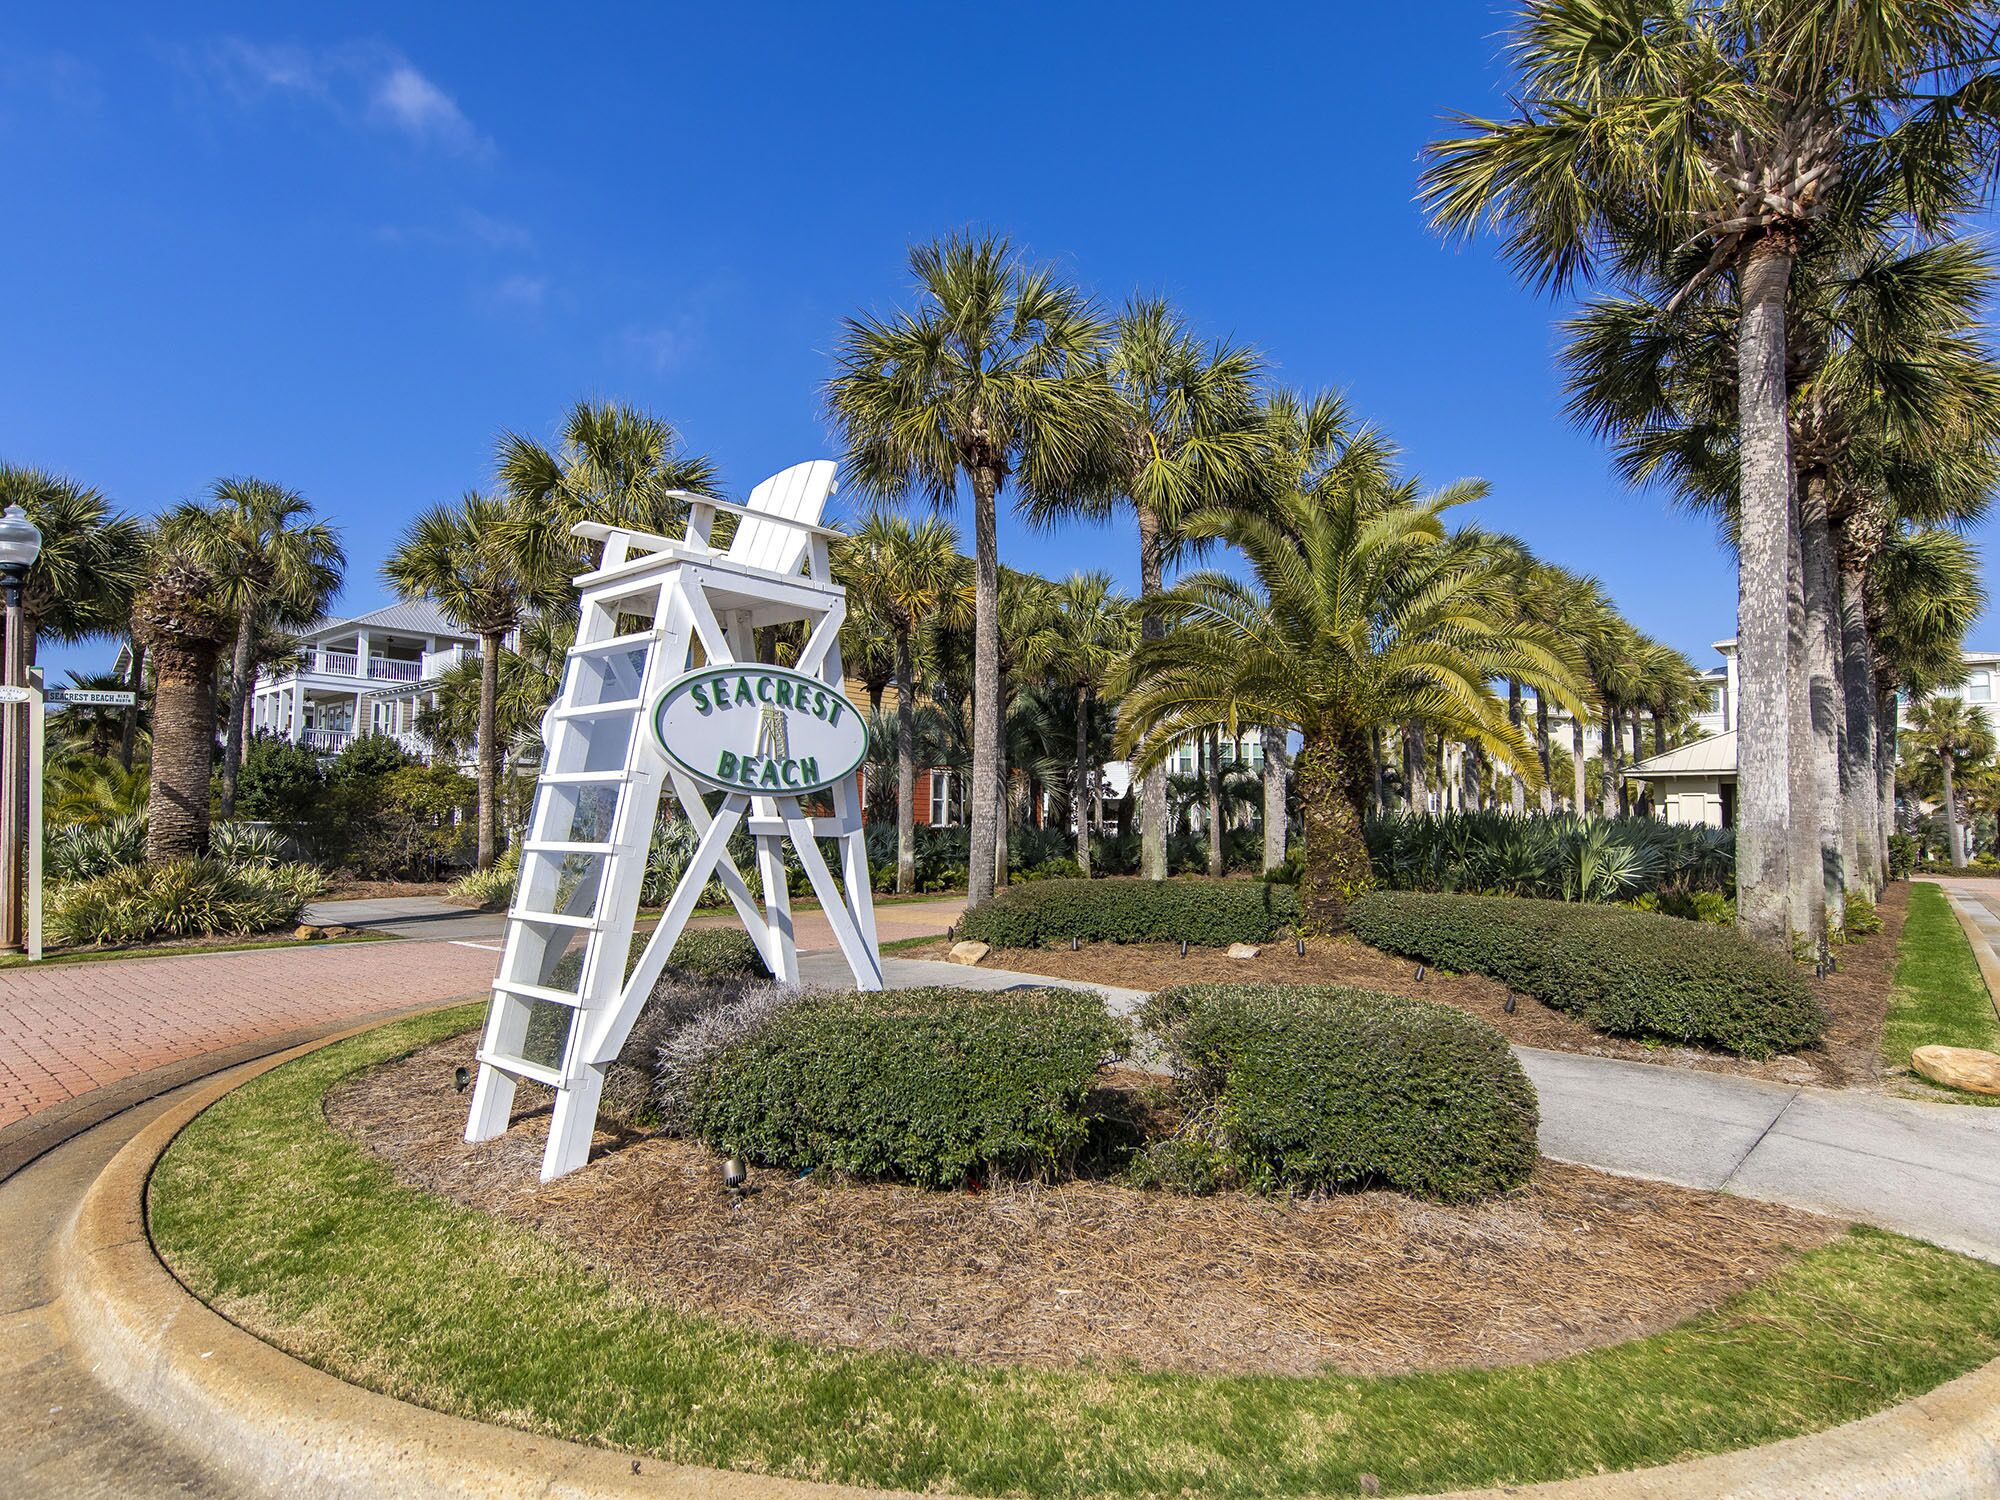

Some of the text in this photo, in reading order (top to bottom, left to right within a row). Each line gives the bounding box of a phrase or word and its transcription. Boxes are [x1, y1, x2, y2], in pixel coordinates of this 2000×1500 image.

[50, 692, 115, 702] SEACREST BEACH
[690, 675, 844, 724] SEACREST
[716, 750, 819, 786] BEACH
